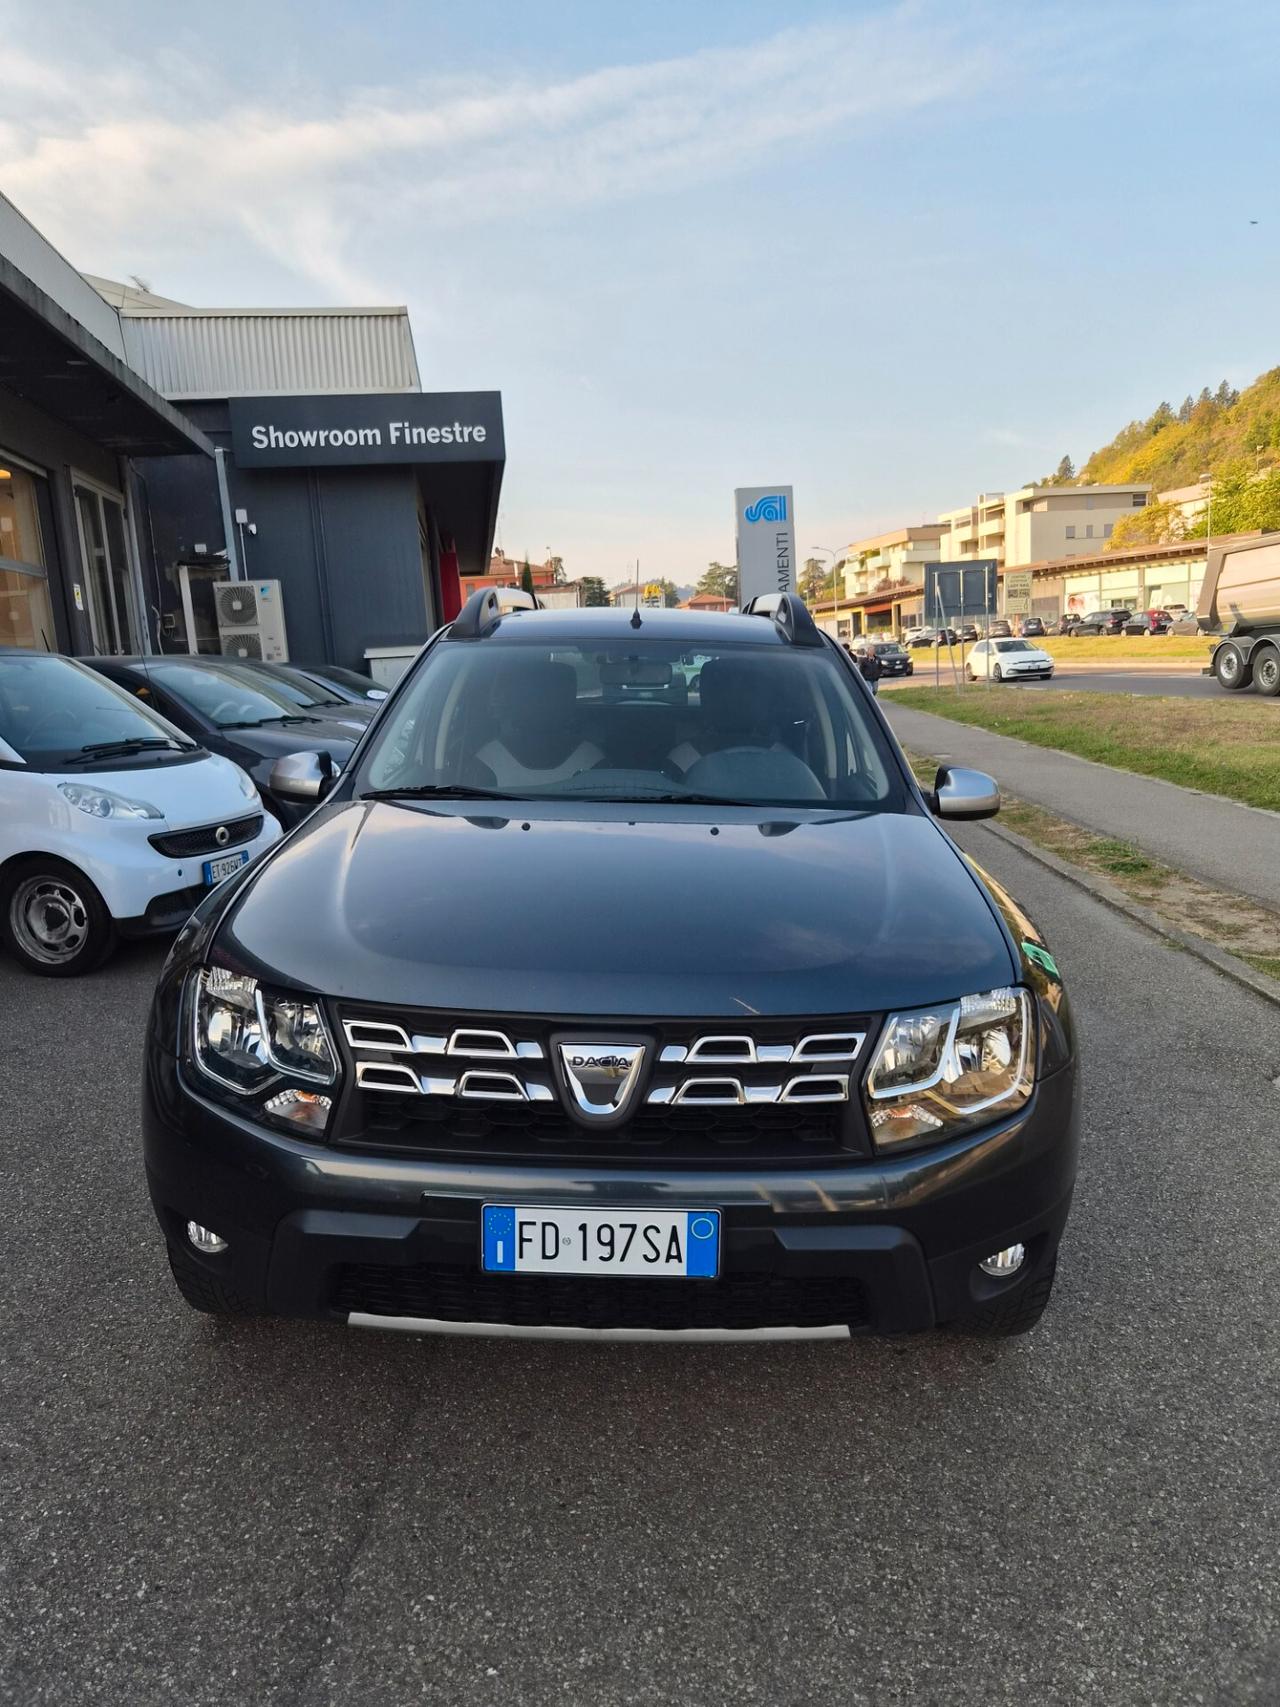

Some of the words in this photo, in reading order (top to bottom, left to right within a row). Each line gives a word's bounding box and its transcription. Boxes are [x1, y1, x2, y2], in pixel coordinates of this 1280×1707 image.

[251, 425, 382, 449] Showroom
[389, 422, 487, 445] Finestre
[776, 532, 790, 593] AMENTI
[572, 1055, 630, 1069] DACIA
[518, 1221, 560, 1260] FD
[578, 1222, 683, 1264] 197SA
